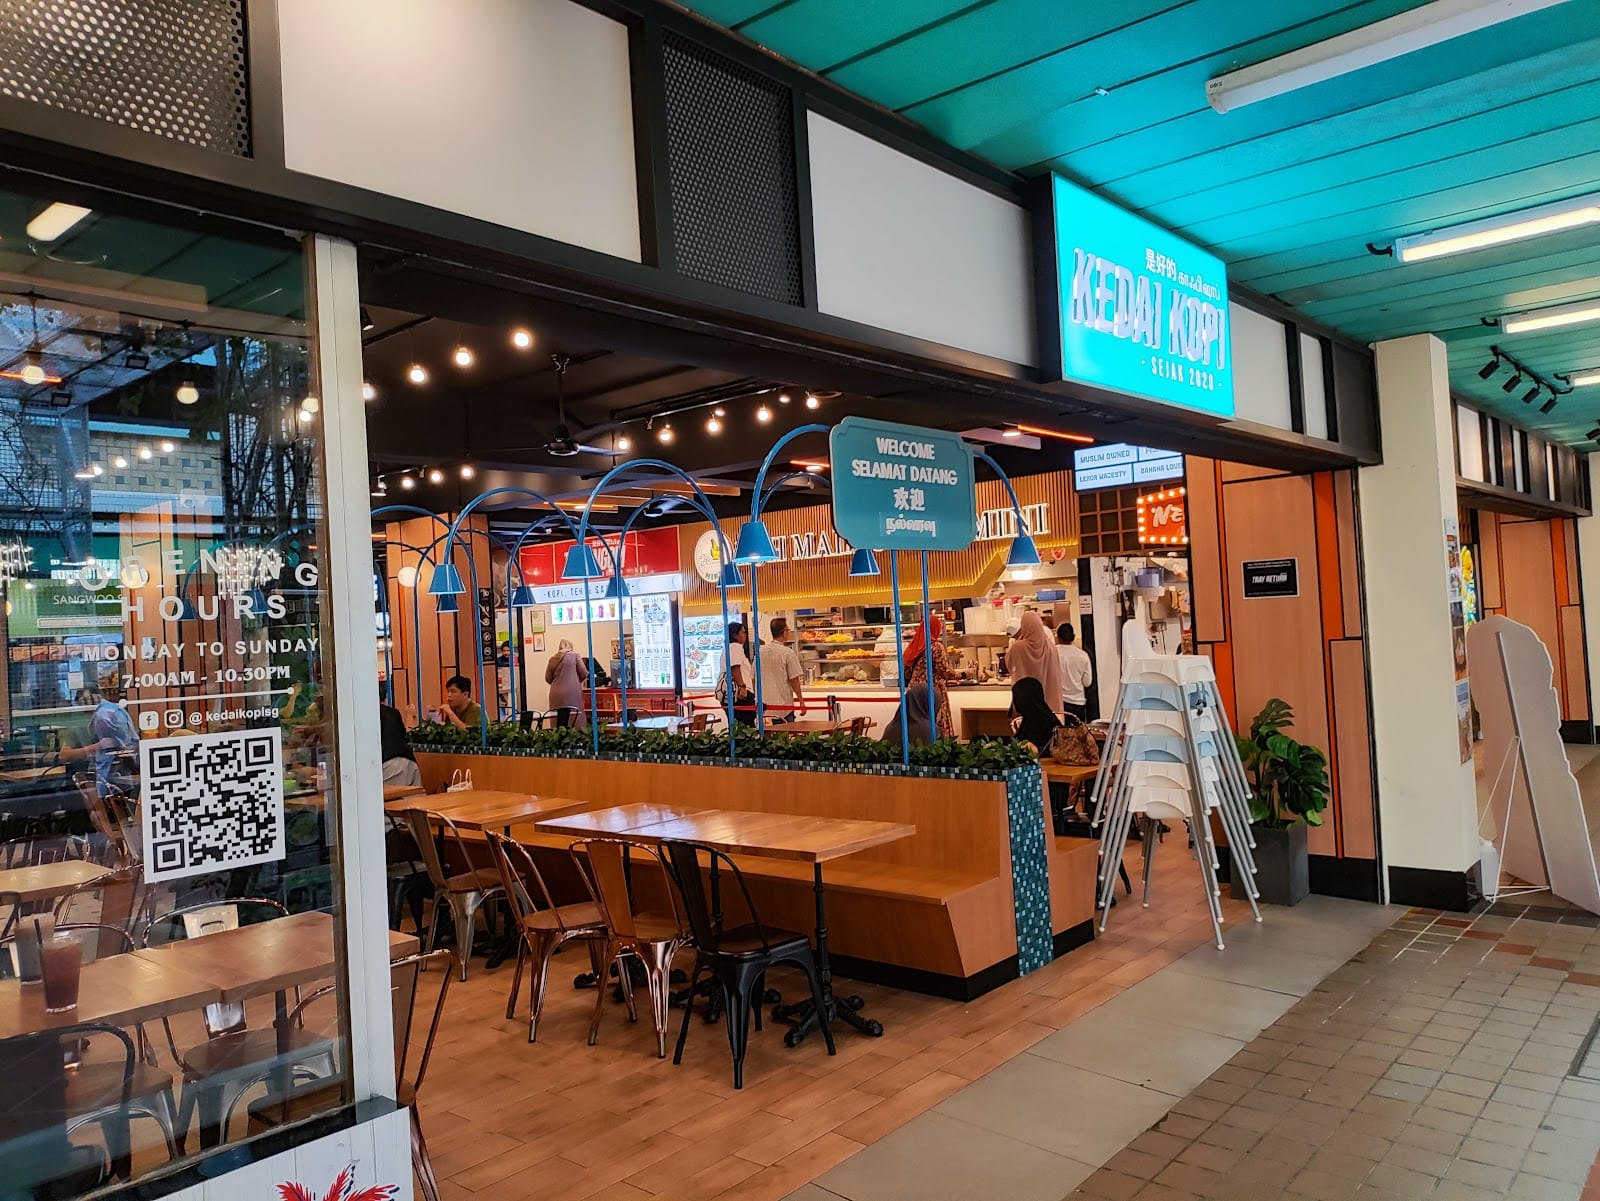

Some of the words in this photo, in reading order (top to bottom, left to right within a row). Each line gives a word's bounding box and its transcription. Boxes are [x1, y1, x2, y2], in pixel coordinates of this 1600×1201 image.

[1145, 247, 1177, 281] 是好的
[1072, 248, 1162, 350] KEDAI
[1169, 289, 1225, 370] KOPI
[1151, 356, 1184, 383] SEJAK
[1189, 367, 1215, 391] 2020
[876, 437, 935, 460] WELCOME
[1080, 452, 1105, 464] MUSLIM
[852, 459, 907, 482] SELAMAT
[910, 465, 958, 486] DATANG
[893, 487, 925, 511] 欢迎
[122, 594, 287, 622] HOURS
[83, 642, 185, 662] MONDAY
[196, 641, 224, 657] TO
[235, 637, 319, 656] SUNDAY
[122, 670, 196, 689] 7:00AM
[214, 665, 291, 684] 10.30PM
